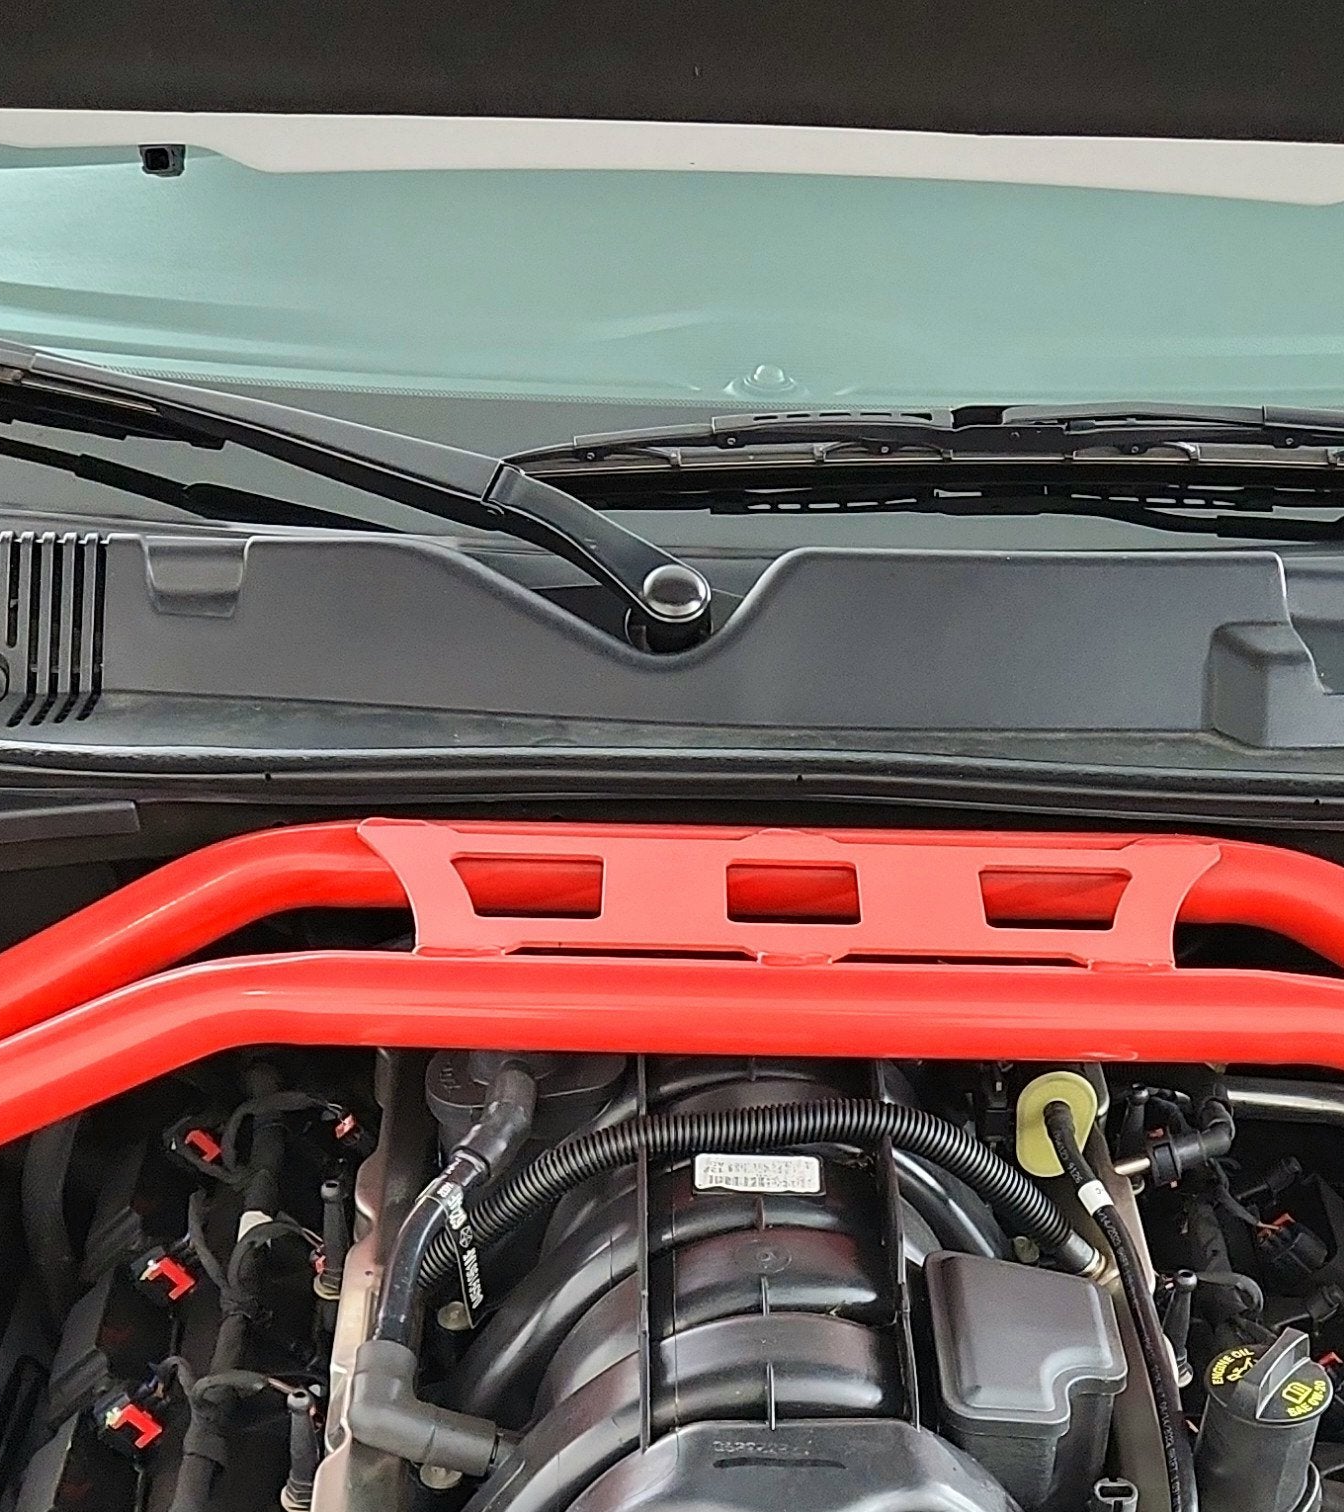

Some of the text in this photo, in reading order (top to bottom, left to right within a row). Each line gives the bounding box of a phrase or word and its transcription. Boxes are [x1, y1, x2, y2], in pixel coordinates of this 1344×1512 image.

[1211, 1348, 1255, 1385] ENGINE OIL
[1286, 1379, 1327, 1417] SAE 0W-20
